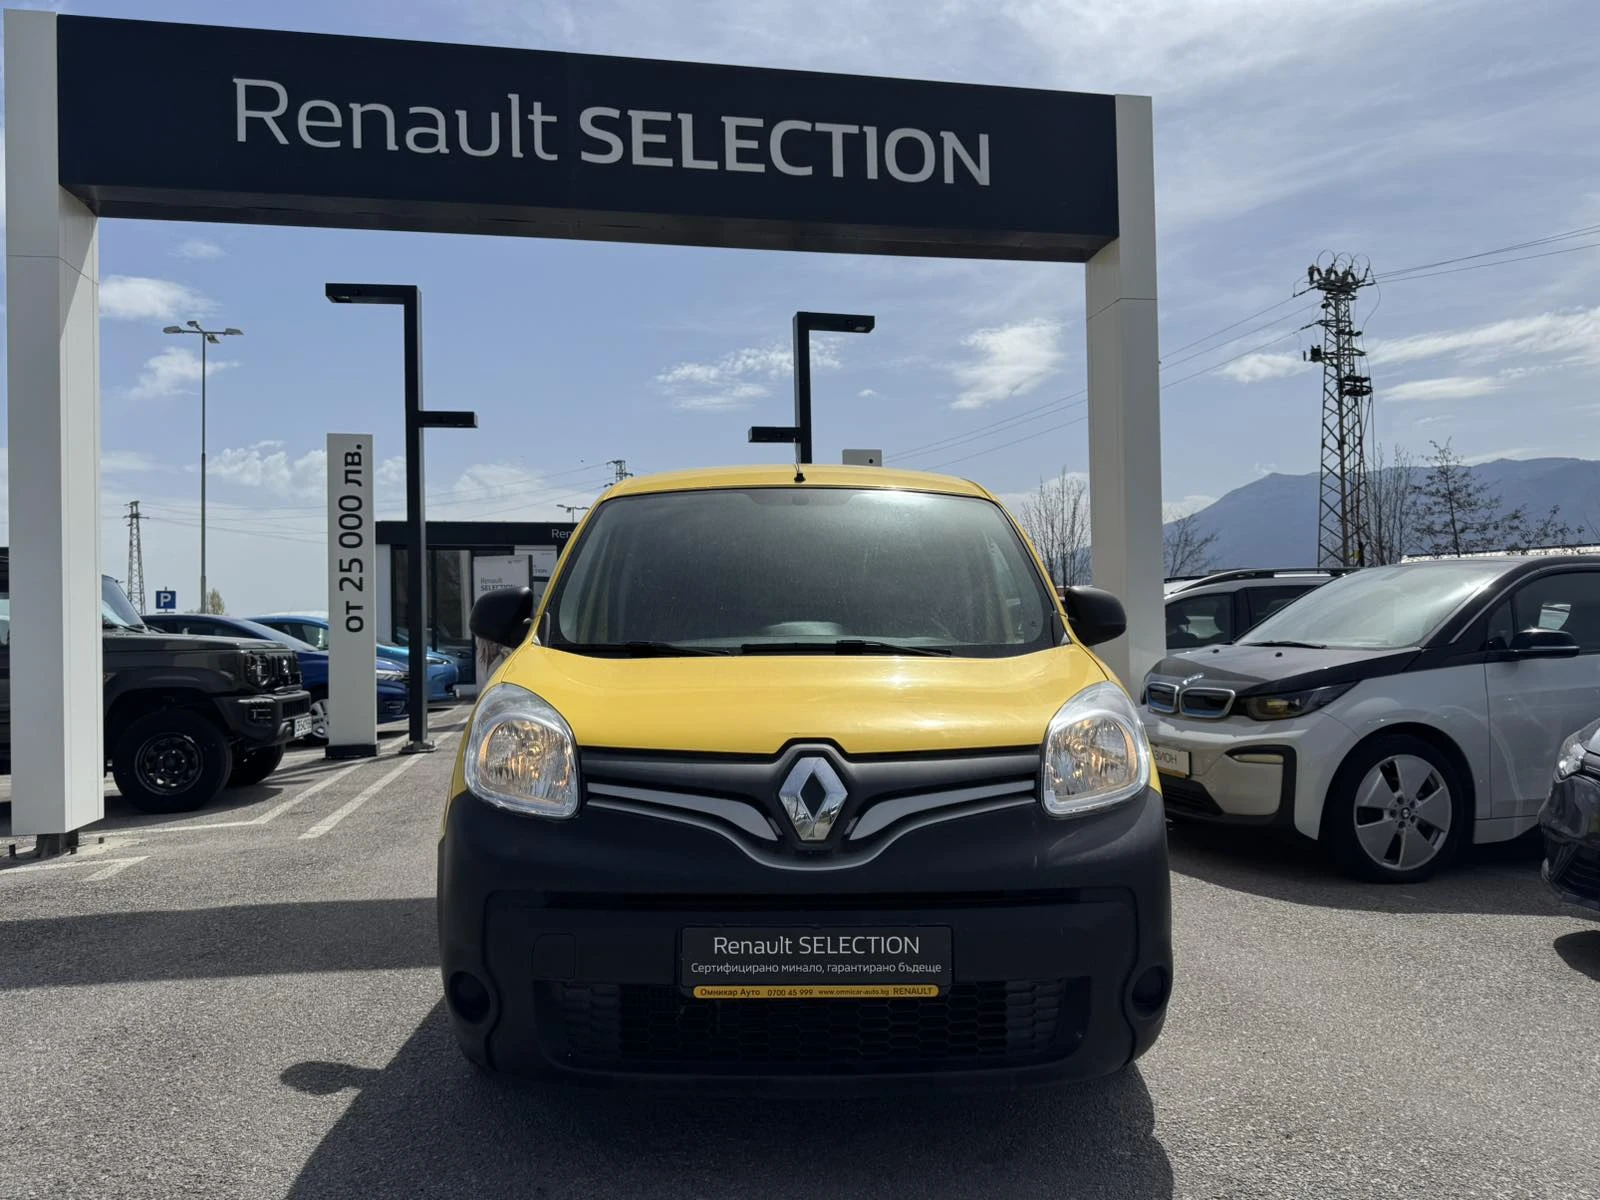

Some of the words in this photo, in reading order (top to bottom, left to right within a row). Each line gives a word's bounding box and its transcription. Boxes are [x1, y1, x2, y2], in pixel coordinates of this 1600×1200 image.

[233, 77, 558, 161] Renault
[579, 106, 991, 186] SELECTION
[344, 443, 362, 487] лв.
[339, 495, 363, 549] 000
[339, 558, 363, 592] 25
[160, 592, 171, 607] P
[345, 601, 364, 633] от
[714, 936, 793, 954] Renault
[799, 936, 920, 954] SELECTION
[691, 962, 779, 975] Сертифицирано
[781, 964, 825, 975] минало,
[827, 964, 896, 975] гарантирано
[898, 962, 942, 974] бъдеще
[700, 988, 738, 997] Омникар
[740, 988, 761, 997] Ауто
[767, 989, 786, 997] 0700
[787, 989, 798, 997] 45
[799, 988, 814, 996] 999
[893, 987, 933, 995] RENAULT
